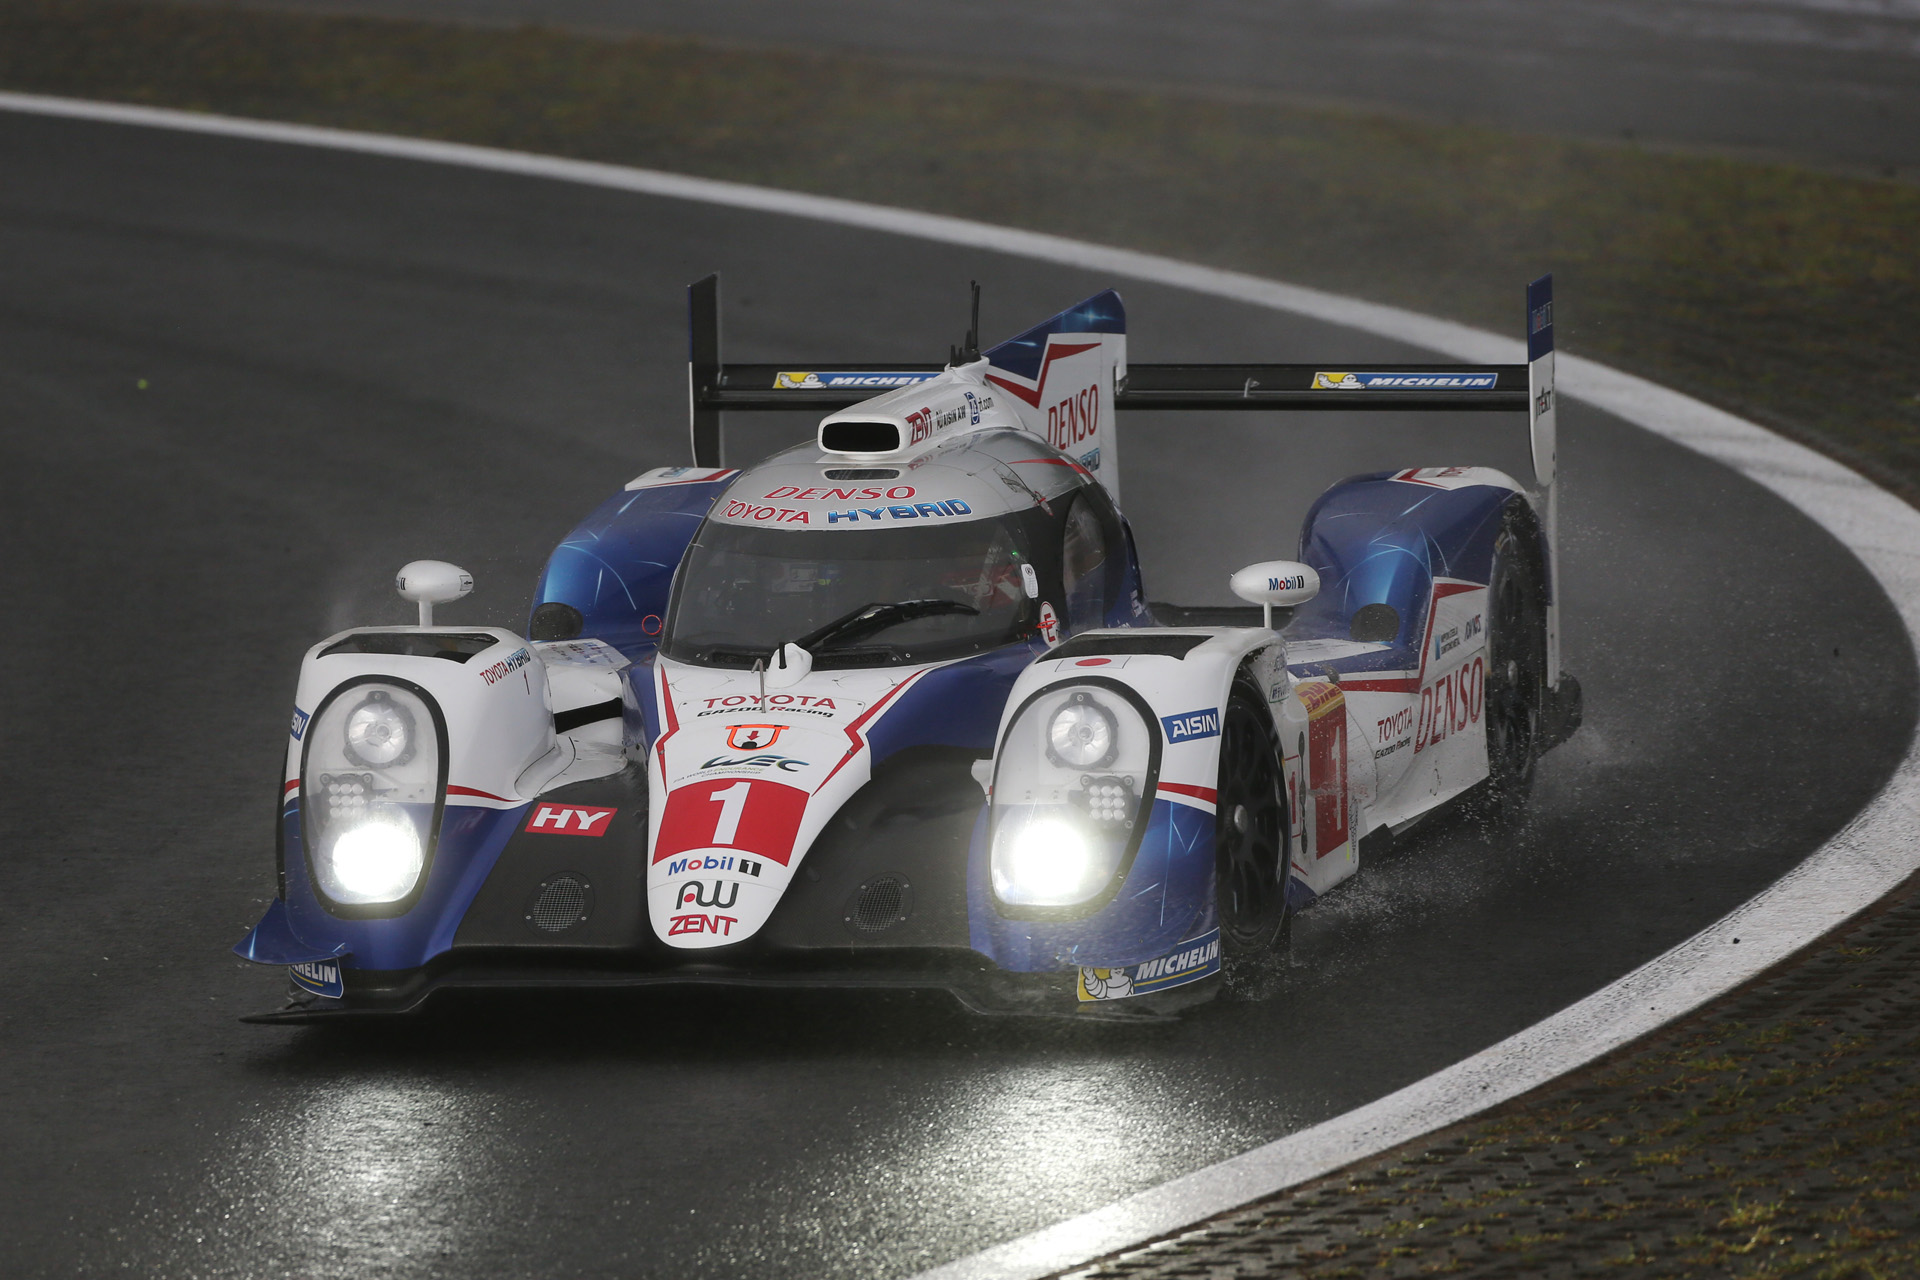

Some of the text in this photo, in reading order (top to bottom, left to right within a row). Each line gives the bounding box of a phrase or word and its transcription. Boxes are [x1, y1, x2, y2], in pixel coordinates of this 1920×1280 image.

[1368, 378, 1492, 386] MICHELIN
[905, 407, 931, 446] ZENT
[1048, 384, 1098, 450] DENSO
[764, 486, 915, 499] DENSO
[719, 500, 972, 524] TOYOTA HYBRID
[1268, 577, 1296, 590] Mobil
[479, 661, 509, 686] TOYOTA
[505, 648, 531, 673] HYBRID
[697, 707, 834, 718] GAZOO Racing
[703, 695, 836, 709] TOYOTA
[1414, 656, 1483, 755] DENSO
[1172, 713, 1217, 738] AISIN
[1377, 706, 1412, 743] TOYOTA
[700, 755, 810, 772] WEC
[1331, 726, 1342, 830] 1
[532, 807, 610, 830] HY
[709, 781, 751, 845] 1
[668, 856, 758, 876] Mobil 1
[668, 914, 738, 936] ZENT
[1136, 939, 1219, 980] MICHELIN
